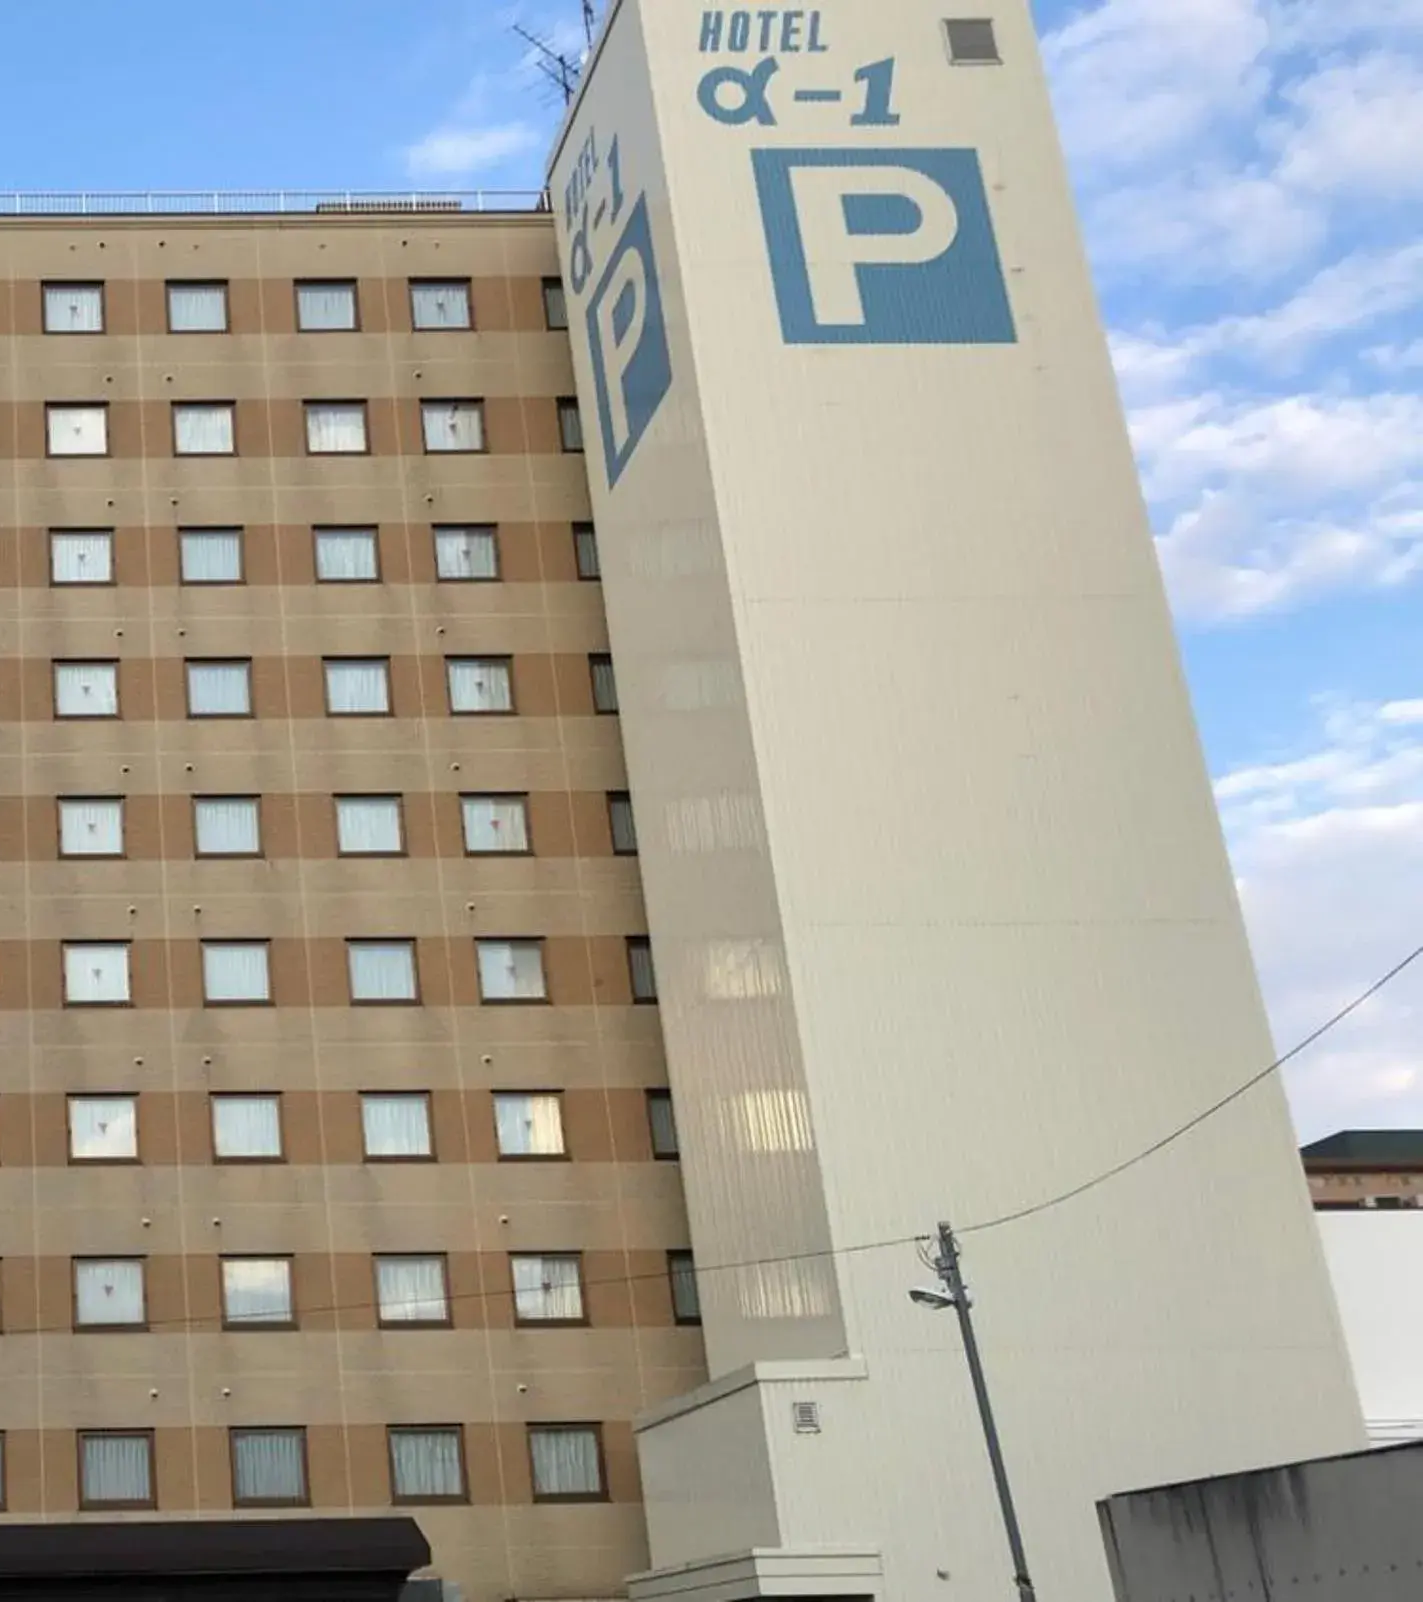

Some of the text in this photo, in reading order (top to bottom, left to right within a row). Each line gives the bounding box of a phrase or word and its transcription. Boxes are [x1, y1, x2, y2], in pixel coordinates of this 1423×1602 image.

[698, 10, 829, 53] HOTEL
[787, 165, 959, 326] P
[596, 246, 647, 456] P
